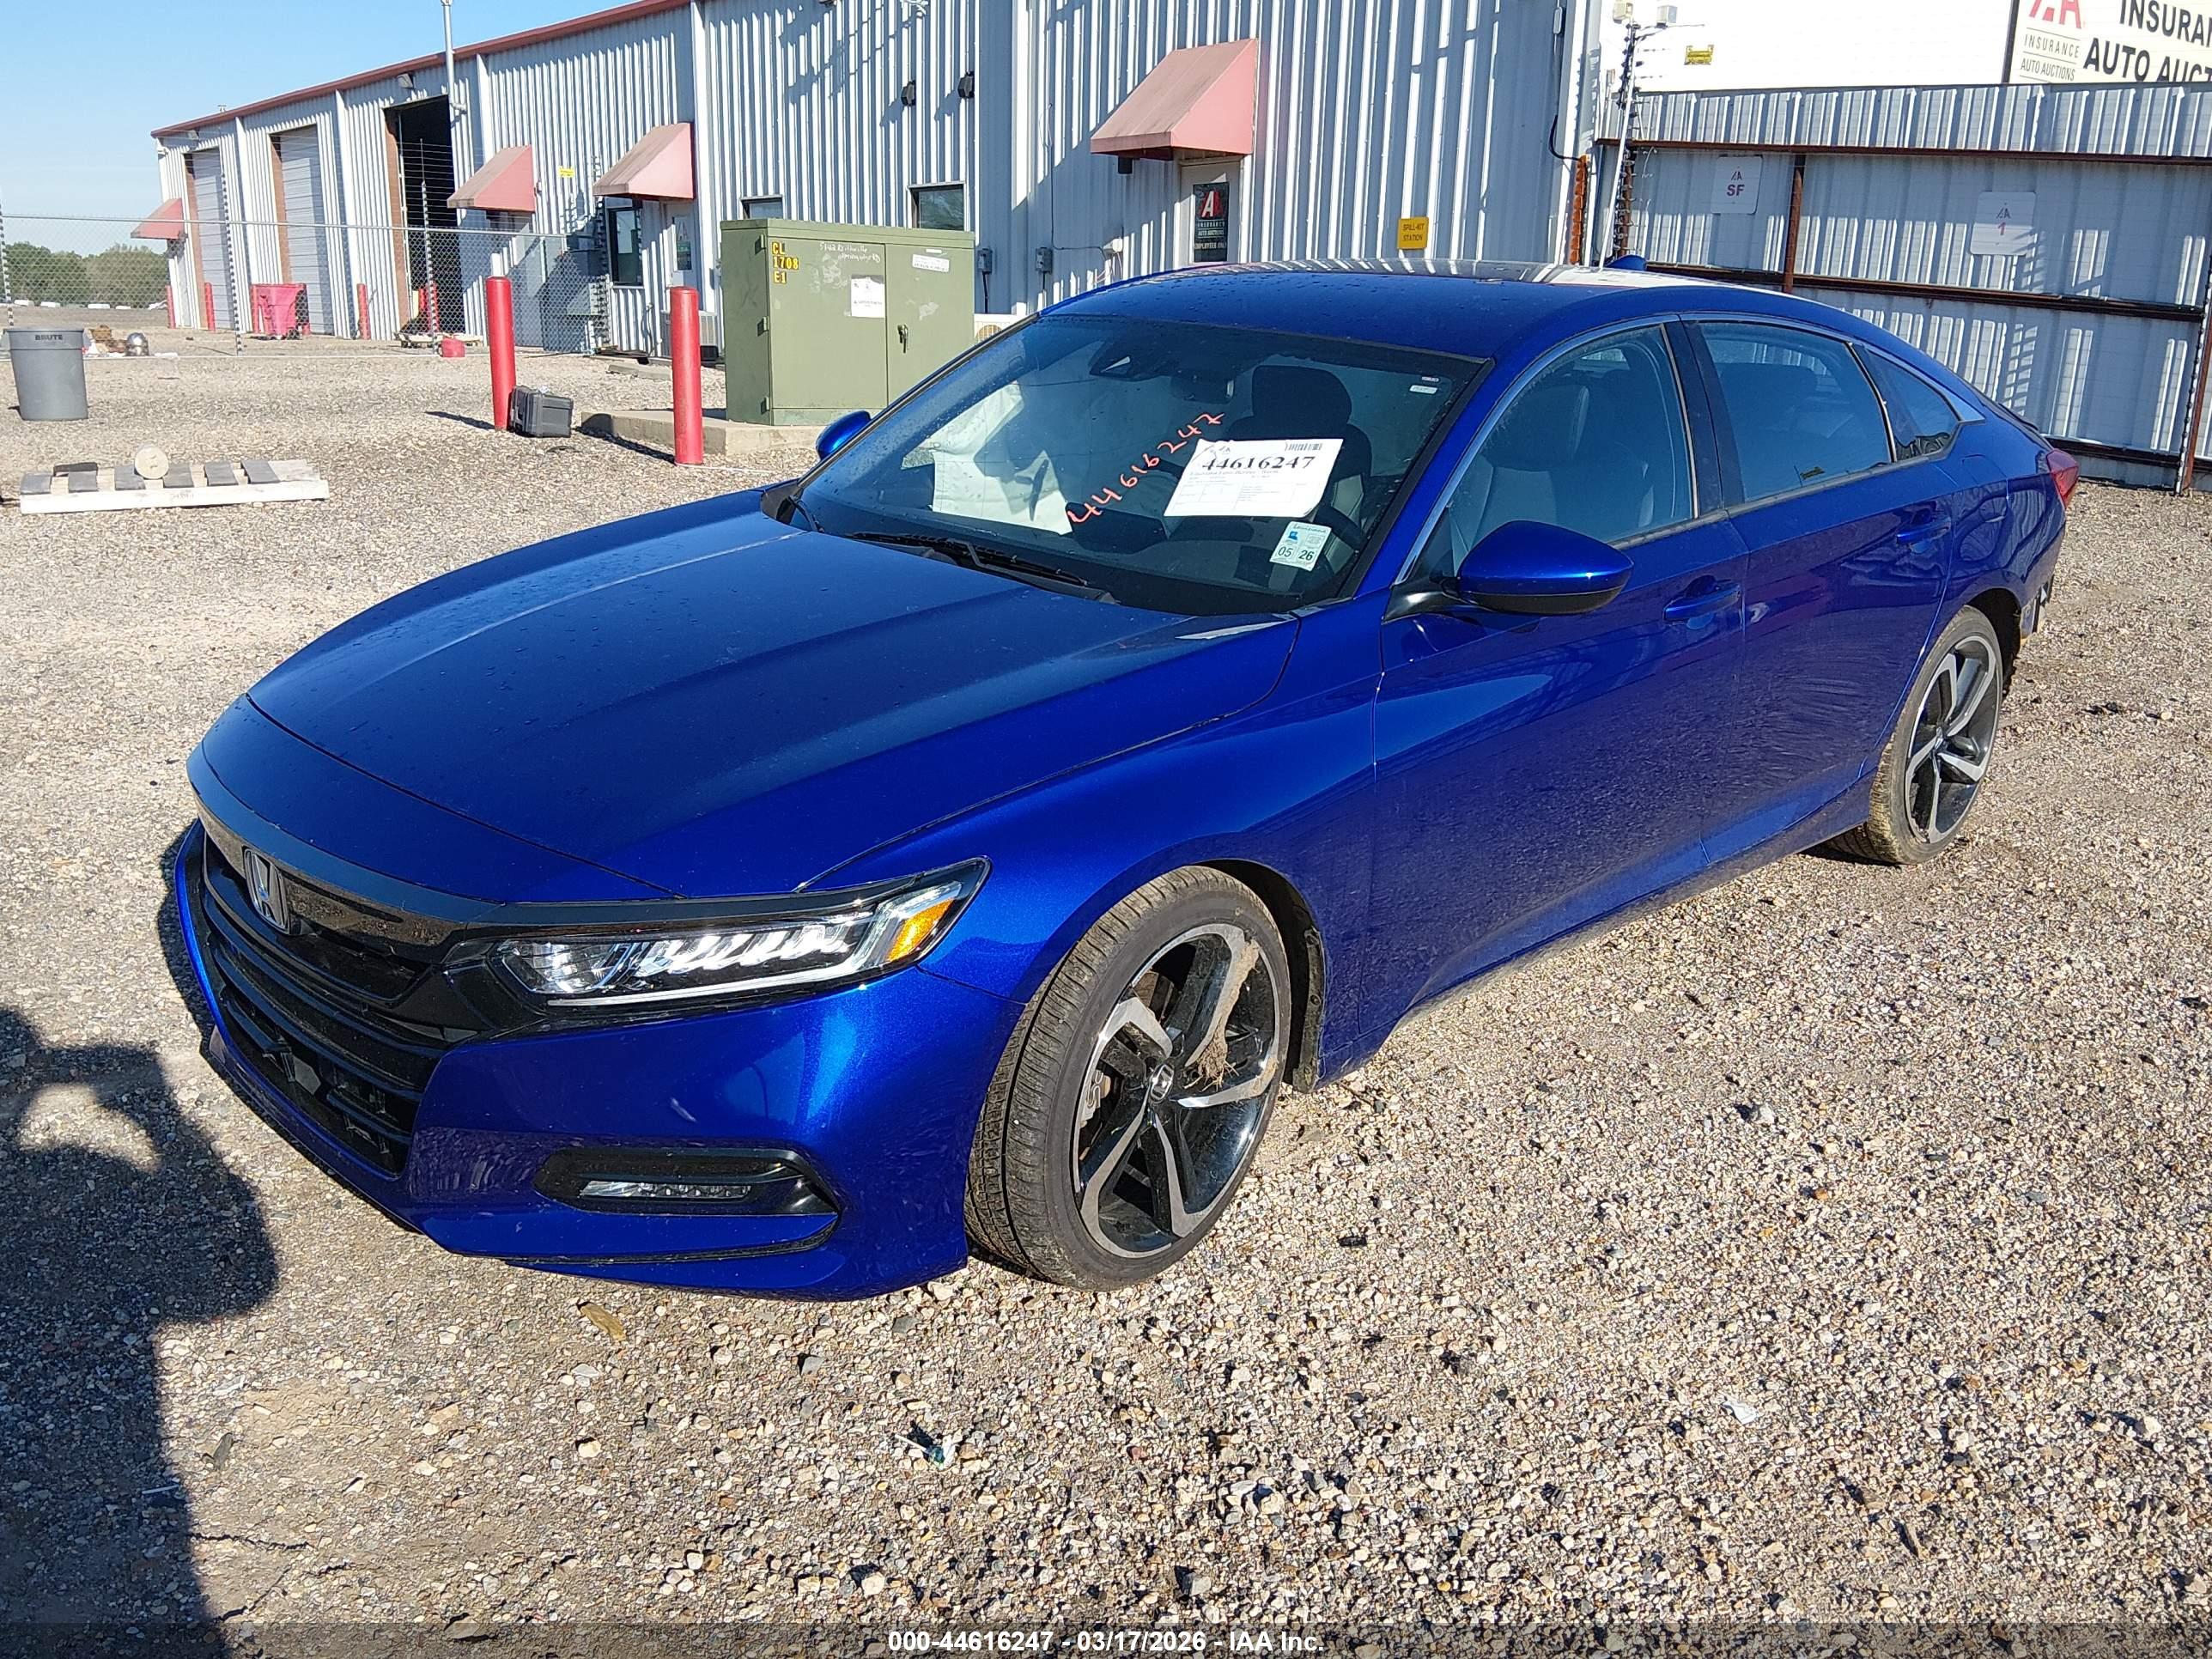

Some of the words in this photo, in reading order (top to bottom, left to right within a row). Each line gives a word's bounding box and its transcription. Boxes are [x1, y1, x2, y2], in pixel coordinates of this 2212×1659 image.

[2023, 33, 2080, 59] INSURANCE
[2083, 37, 2150, 82] AUTO
[2021, 58, 2040, 74] AUTO
[2040, 62, 2075, 82] AUCTIONS
[1726, 184, 1745, 197] SF
[1997, 222, 2007, 236] 1
[772, 241, 785, 255] CL
[773, 256, 799, 270] 1708
[774, 270, 787, 284] E1
[1202, 456, 1316, 471] 44616247
[1278, 546, 1293, 557] 05
[1298, 550, 1315, 561] 26
